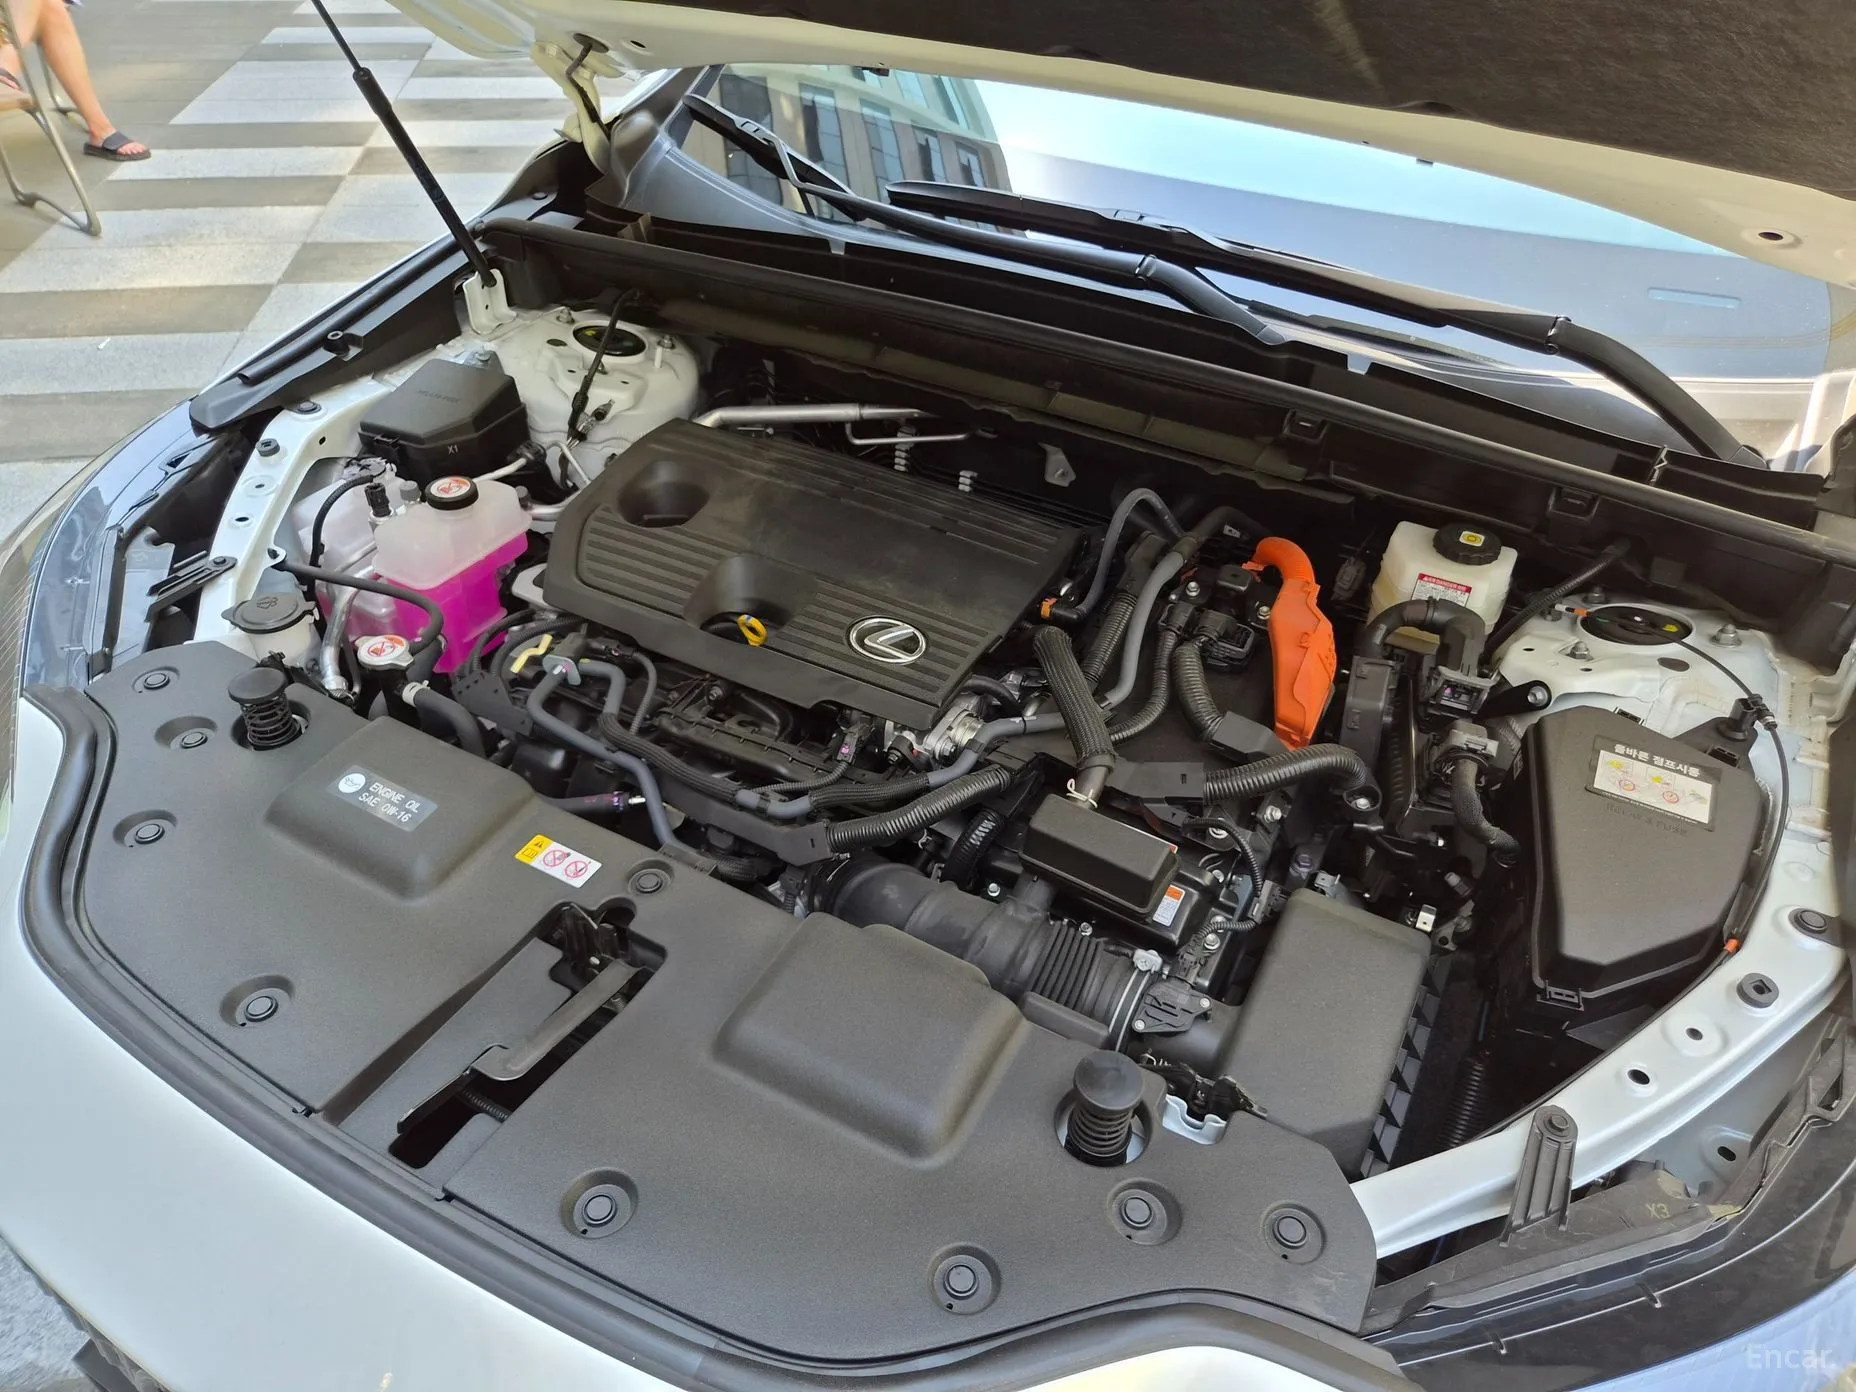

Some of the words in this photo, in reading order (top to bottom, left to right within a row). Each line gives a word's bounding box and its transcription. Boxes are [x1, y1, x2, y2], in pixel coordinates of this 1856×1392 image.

[447, 444, 459, 455] X1
[1652, 755, 1701, 778] 점프시동
[358, 792, 381, 807] SAE
[381, 803, 412, 823] 0W-16
[368, 781, 406, 804] ENGINE
[405, 799, 422, 813] OIL
[1645, 1202, 1671, 1220] X3
